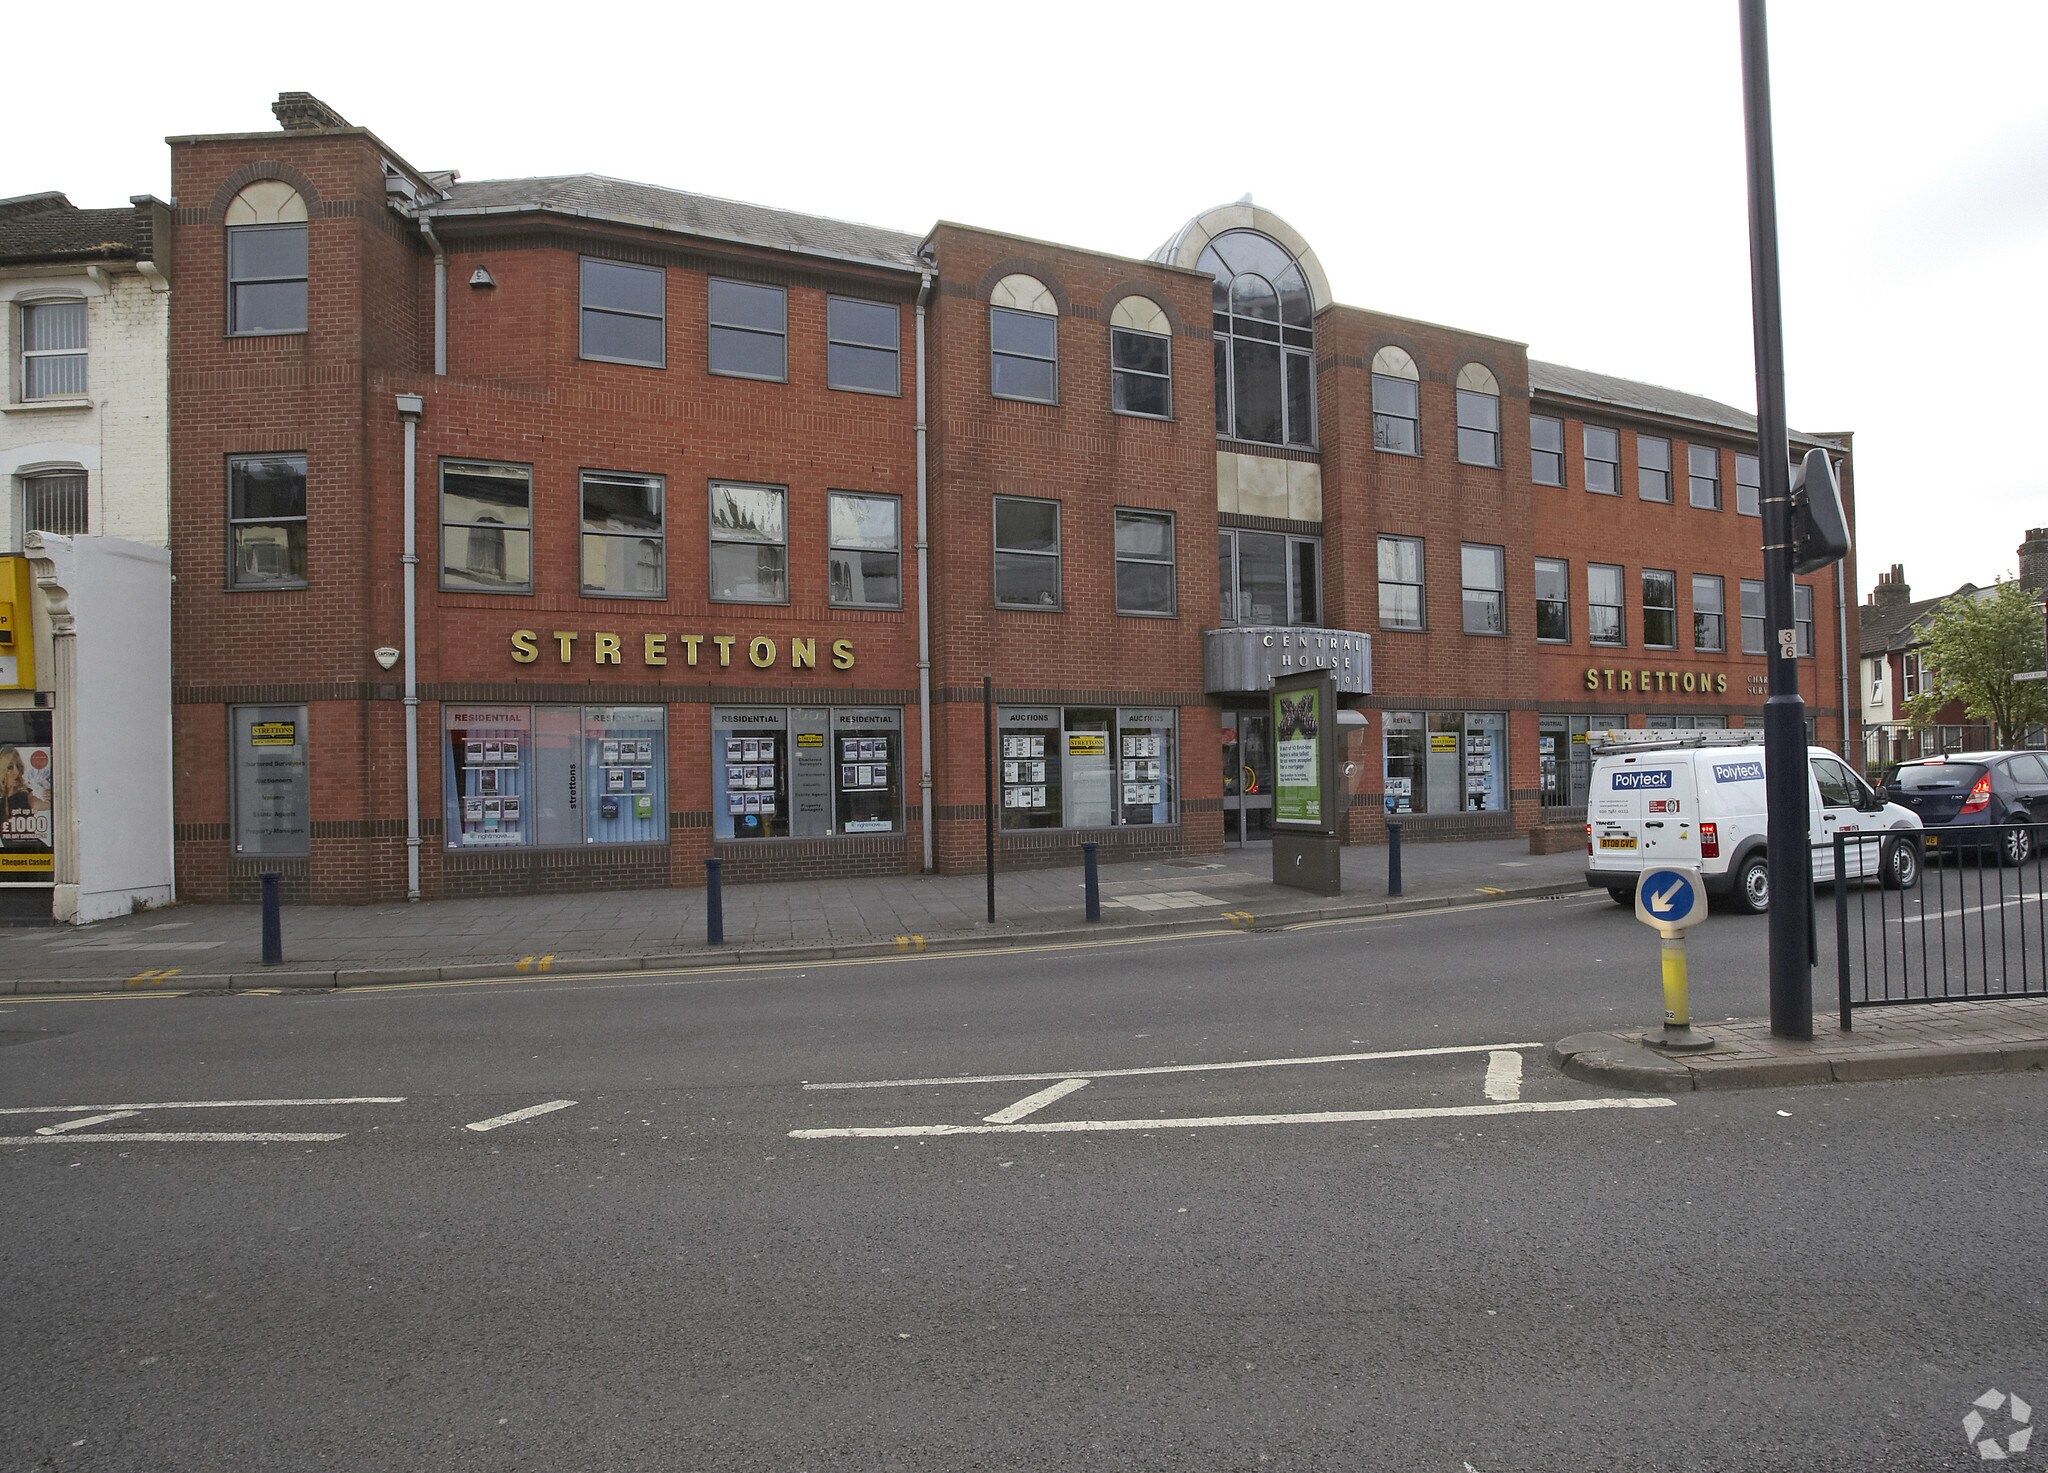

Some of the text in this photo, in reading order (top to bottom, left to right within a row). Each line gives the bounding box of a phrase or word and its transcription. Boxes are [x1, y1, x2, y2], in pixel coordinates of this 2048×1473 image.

[1784, 631, 1792, 643] 3
[1263, 635, 1361, 651] CENTRAL
[511, 630, 855, 669] STRETTONS
[1786, 646, 1794, 657] 6
[1282, 655, 1351, 668] HOUSE
[1586, 668, 1728, 693] STRETTONS
[455, 713, 522, 722] RESIDENTIAL
[593, 714, 656, 722] RESIDENTIAL
[721, 715, 779, 723] RESIDENTIAL
[839, 715, 893, 723] RESIDENTIAL
[1010, 714, 1048, 722] AUCTIONS
[1716, 763, 1760, 780] Polyteck
[1615, 772, 1667, 788] Polyteck
[2, 816, 47, 833] £1000
[1602, 840, 1634, 848] BT08 GVC
[2, 858, 51, 867] Cheques Cashed
